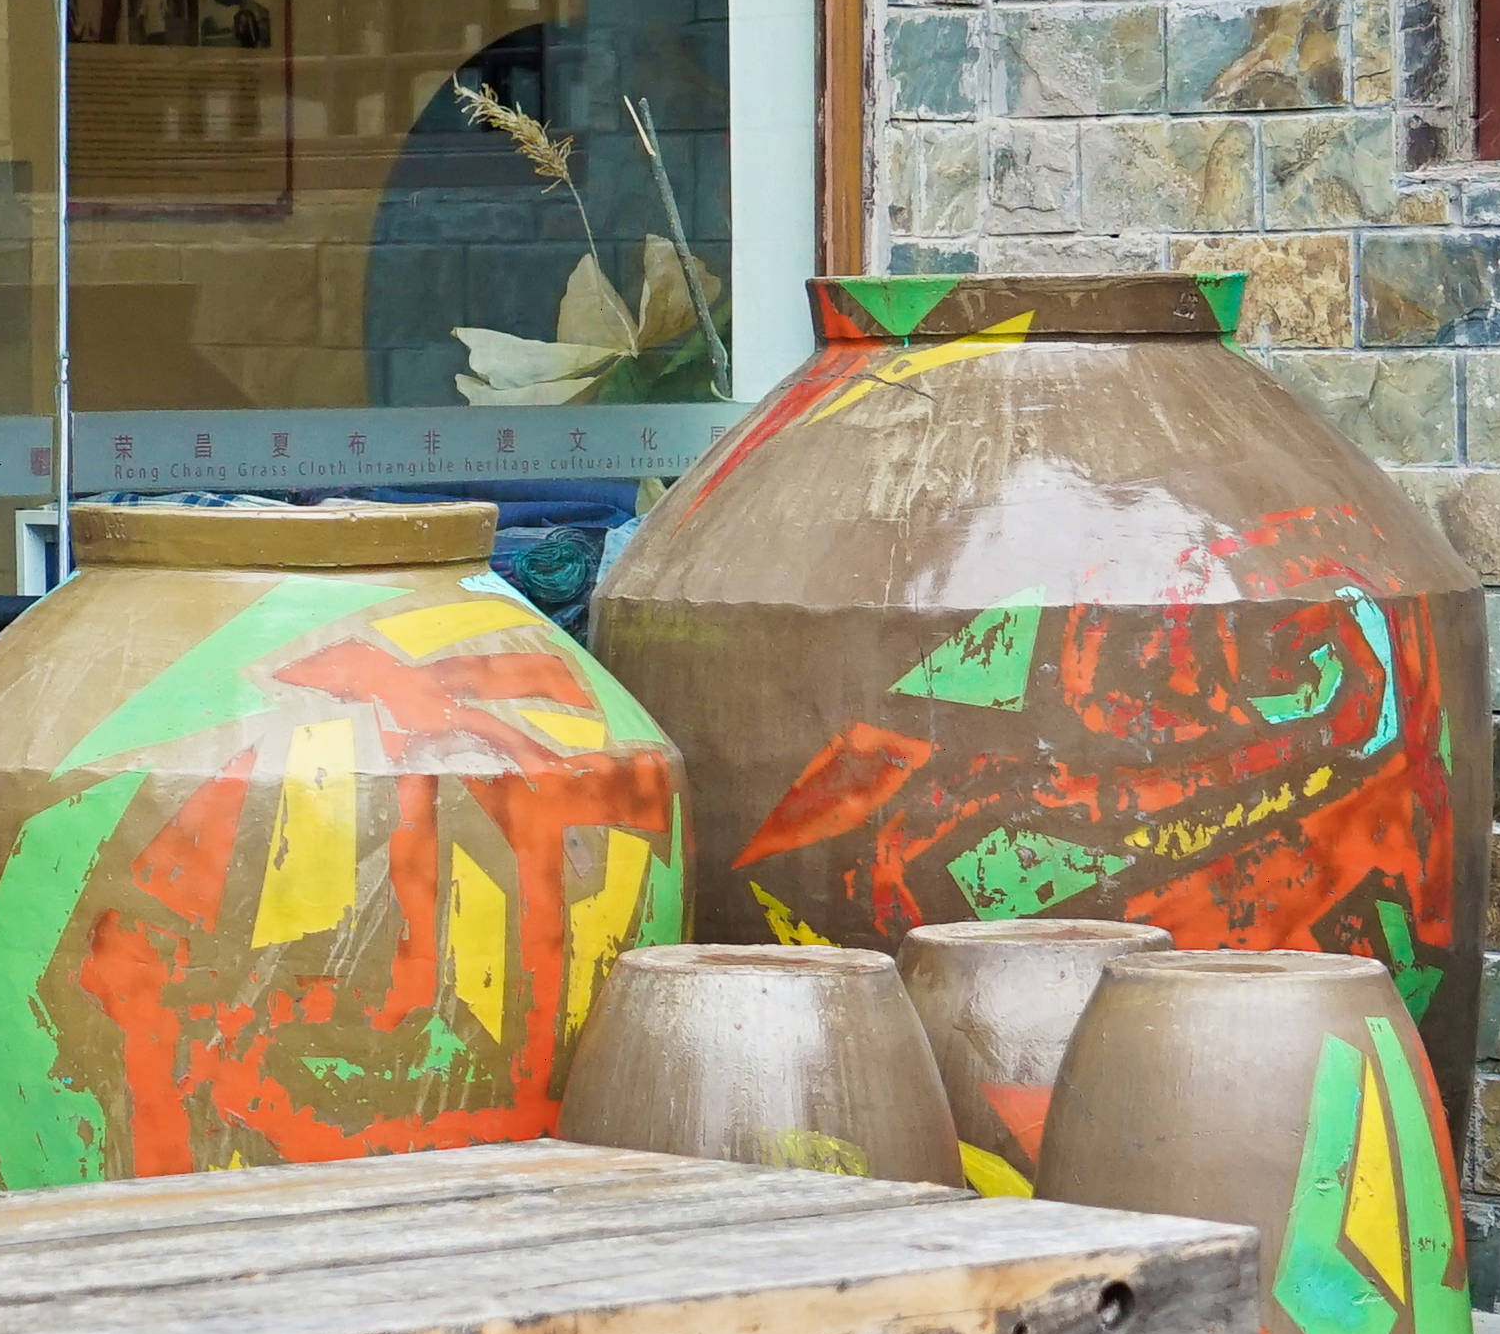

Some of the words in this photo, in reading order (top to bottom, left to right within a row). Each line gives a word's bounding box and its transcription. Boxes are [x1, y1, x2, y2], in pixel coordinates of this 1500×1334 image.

[114, 464, 159, 483] Rong
[170, 463, 226, 482] Chang
[237, 461, 287, 476] Grass
[298, 460, 346, 475] Cloth
[358, 458, 454, 478] Intangible
[464, 456, 540, 475] heritage
[550, 455, 620, 469] cultural
